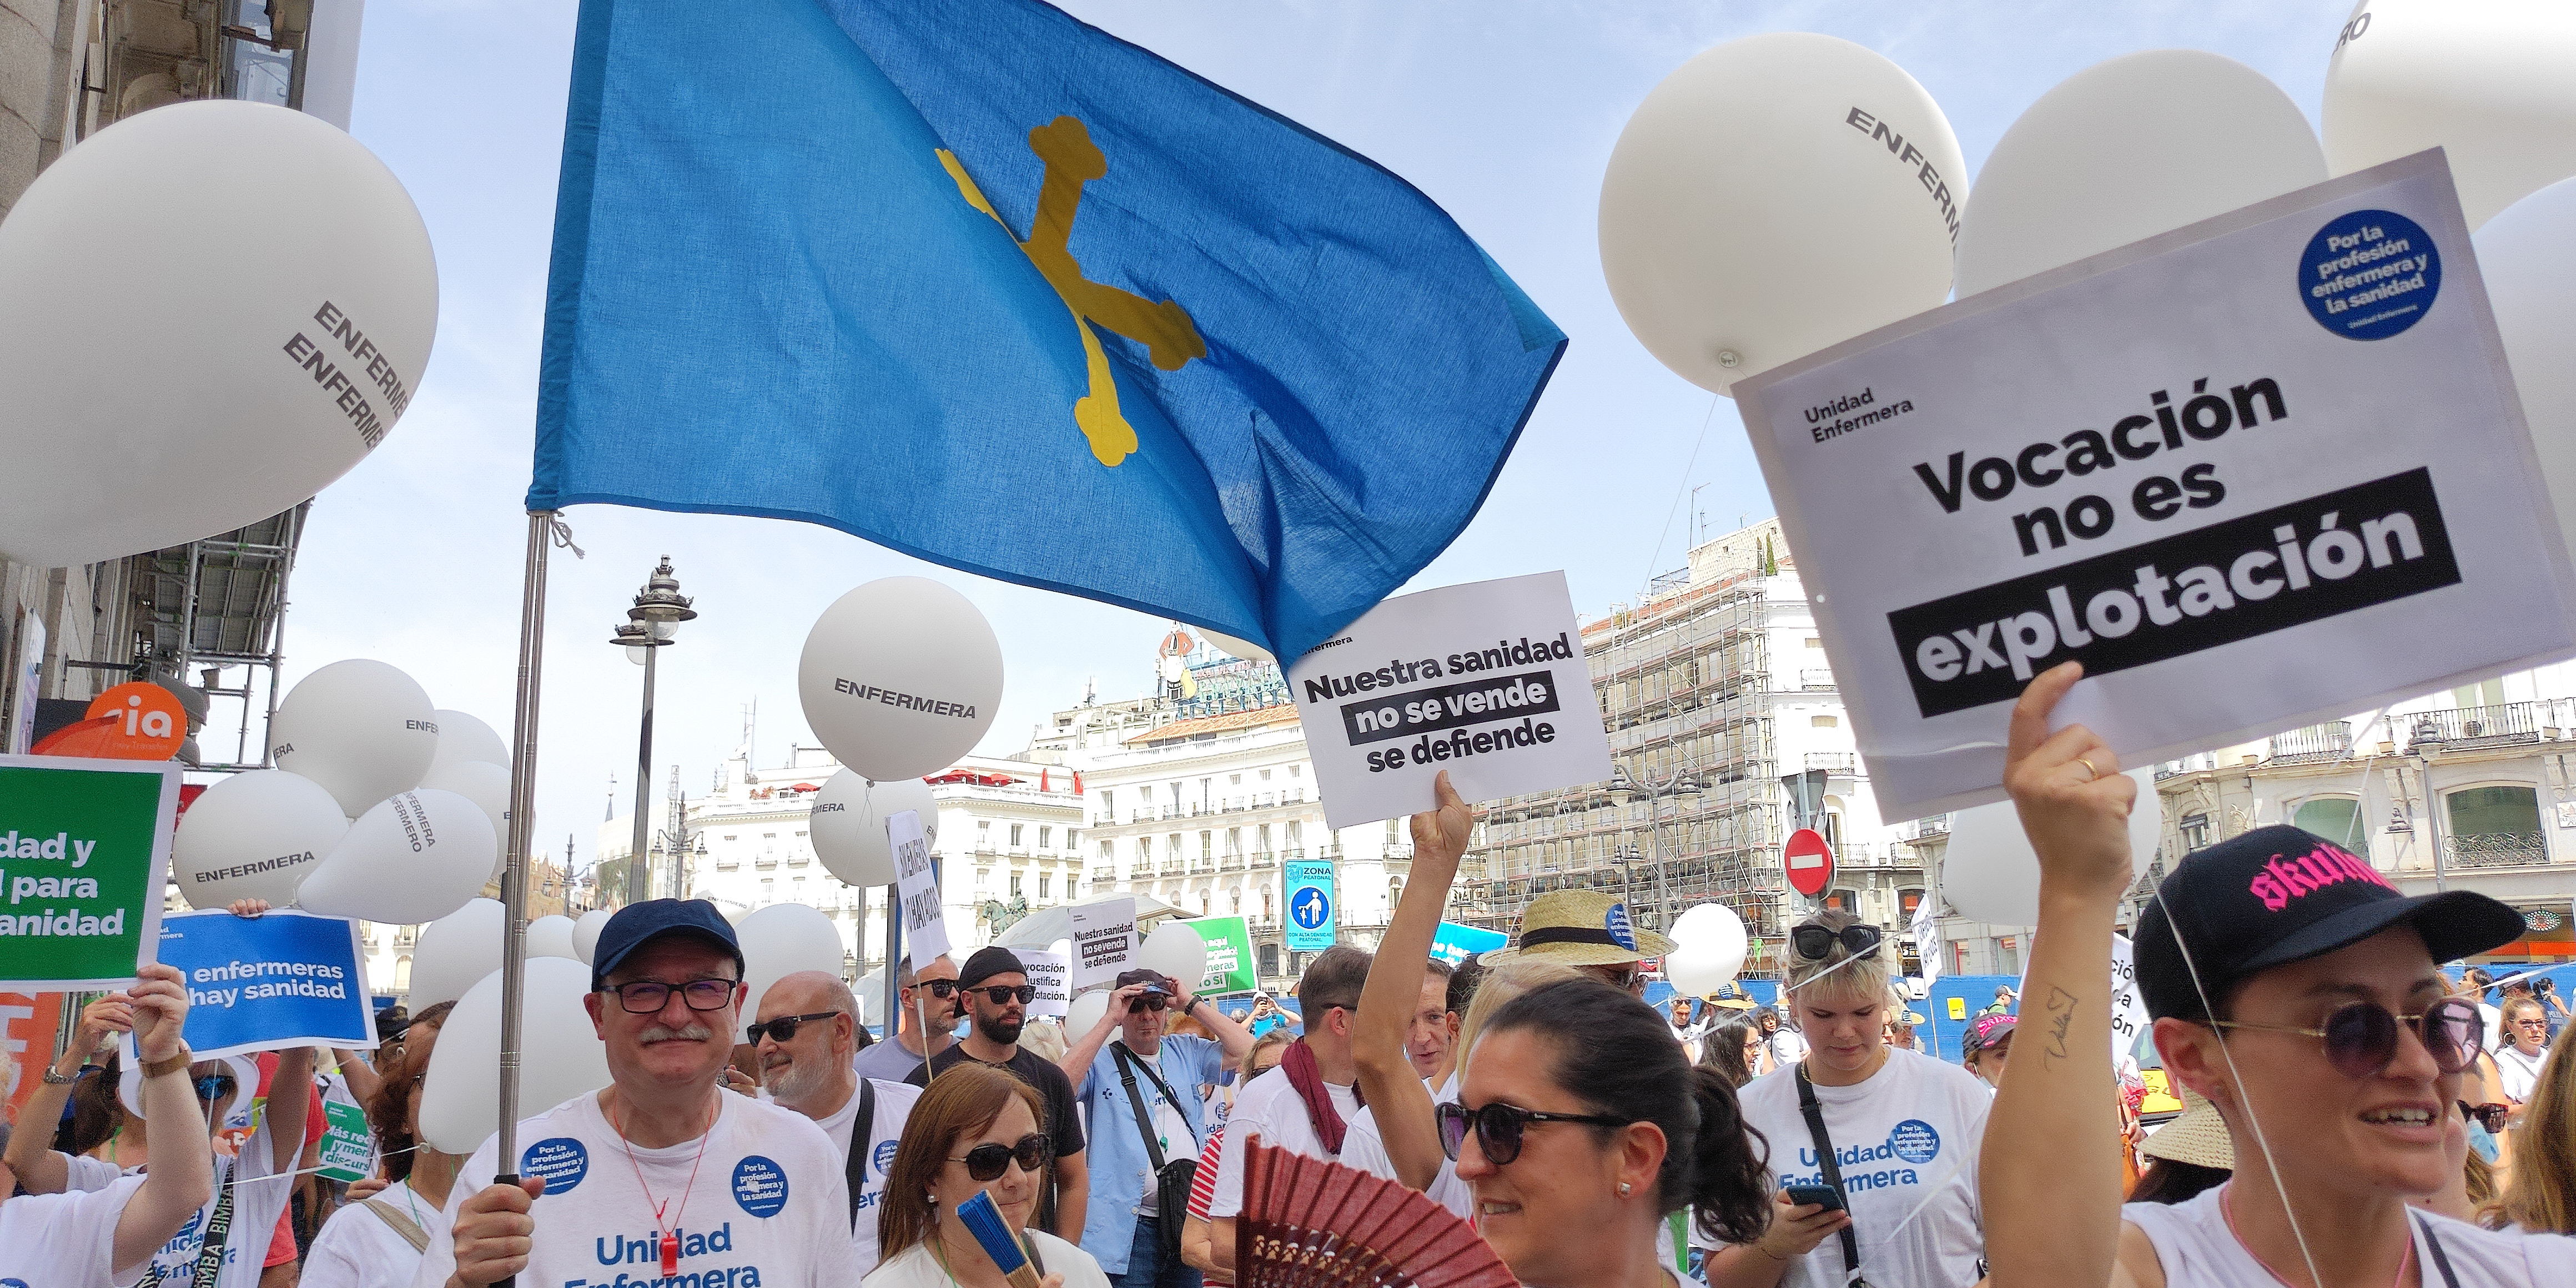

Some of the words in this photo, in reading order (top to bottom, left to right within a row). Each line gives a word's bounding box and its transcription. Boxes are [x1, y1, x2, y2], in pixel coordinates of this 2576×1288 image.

[2326, 231, 2360, 252] Por
[2361, 224, 2385, 242] la
[2317, 238, 2411, 280] profesión
[2311, 258, 2416, 298] enfermera
[2413, 253, 2428, 272] y
[2325, 298, 2349, 315] la
[2348, 271, 2427, 307] sanidad
[1804, 387, 1874, 424] Unidad
[1810, 400, 1914, 444] Enfermera
[1912, 376, 2288, 515] Vocación
[2010, 494, 2115, 557] no
[2131, 462, 2226, 522] es
[1915, 510, 2424, 682] explotación
[1303, 658, 1442, 704] Nuestra
[1446, 632, 1573, 675] sanidad
[834, 677, 977, 720] ENFERMERA
[1355, 706, 1400, 734] no
[1406, 700, 1442, 724] se
[1444, 678, 1547, 717] vende
[104, 695, 172, 738] ia
[1366, 747, 1406, 773] se
[1411, 718, 1556, 766] defiende
[72, 839, 97, 868] y
[195, 850, 315, 884] ENFERMERA
[11, 876, 98, 904] para
[1074, 928, 1103, 942] Nuestra
[1103, 922, 1133, 937] sanidad
[1083, 945, 1093, 955] no
[1092, 944, 1102, 953] se
[1101, 937, 1126, 951] vende
[194, 960, 344, 983] enfermeras
[1024, 963, 1065, 973] vocación
[1084, 959, 1093, 969] se
[1093, 952, 1126, 967] defiende
[189, 987, 239, 1008] hay
[245, 979, 346, 1000] sanidad
[1027, 975, 1061, 987] justifica
[1896, 1130, 1930, 1140] profesión
[526, 1159, 578, 1173] enfermera
[578, 1156, 584, 1165] y
[531, 1150, 577, 1165] profesión
[1799, 1138, 1893, 1168] Uidad
[542, 1165, 581, 1179] sanidad
[739, 1171, 777, 1184] profesión
[744, 1164, 757, 1173] Por
[757, 1163, 767, 1171] la
[742, 1193, 752, 1201] la
[751, 1189, 783, 1200] sanidad
[778, 1181, 784, 1190] y
[209, 1187, 234, 1234] BIMBA
